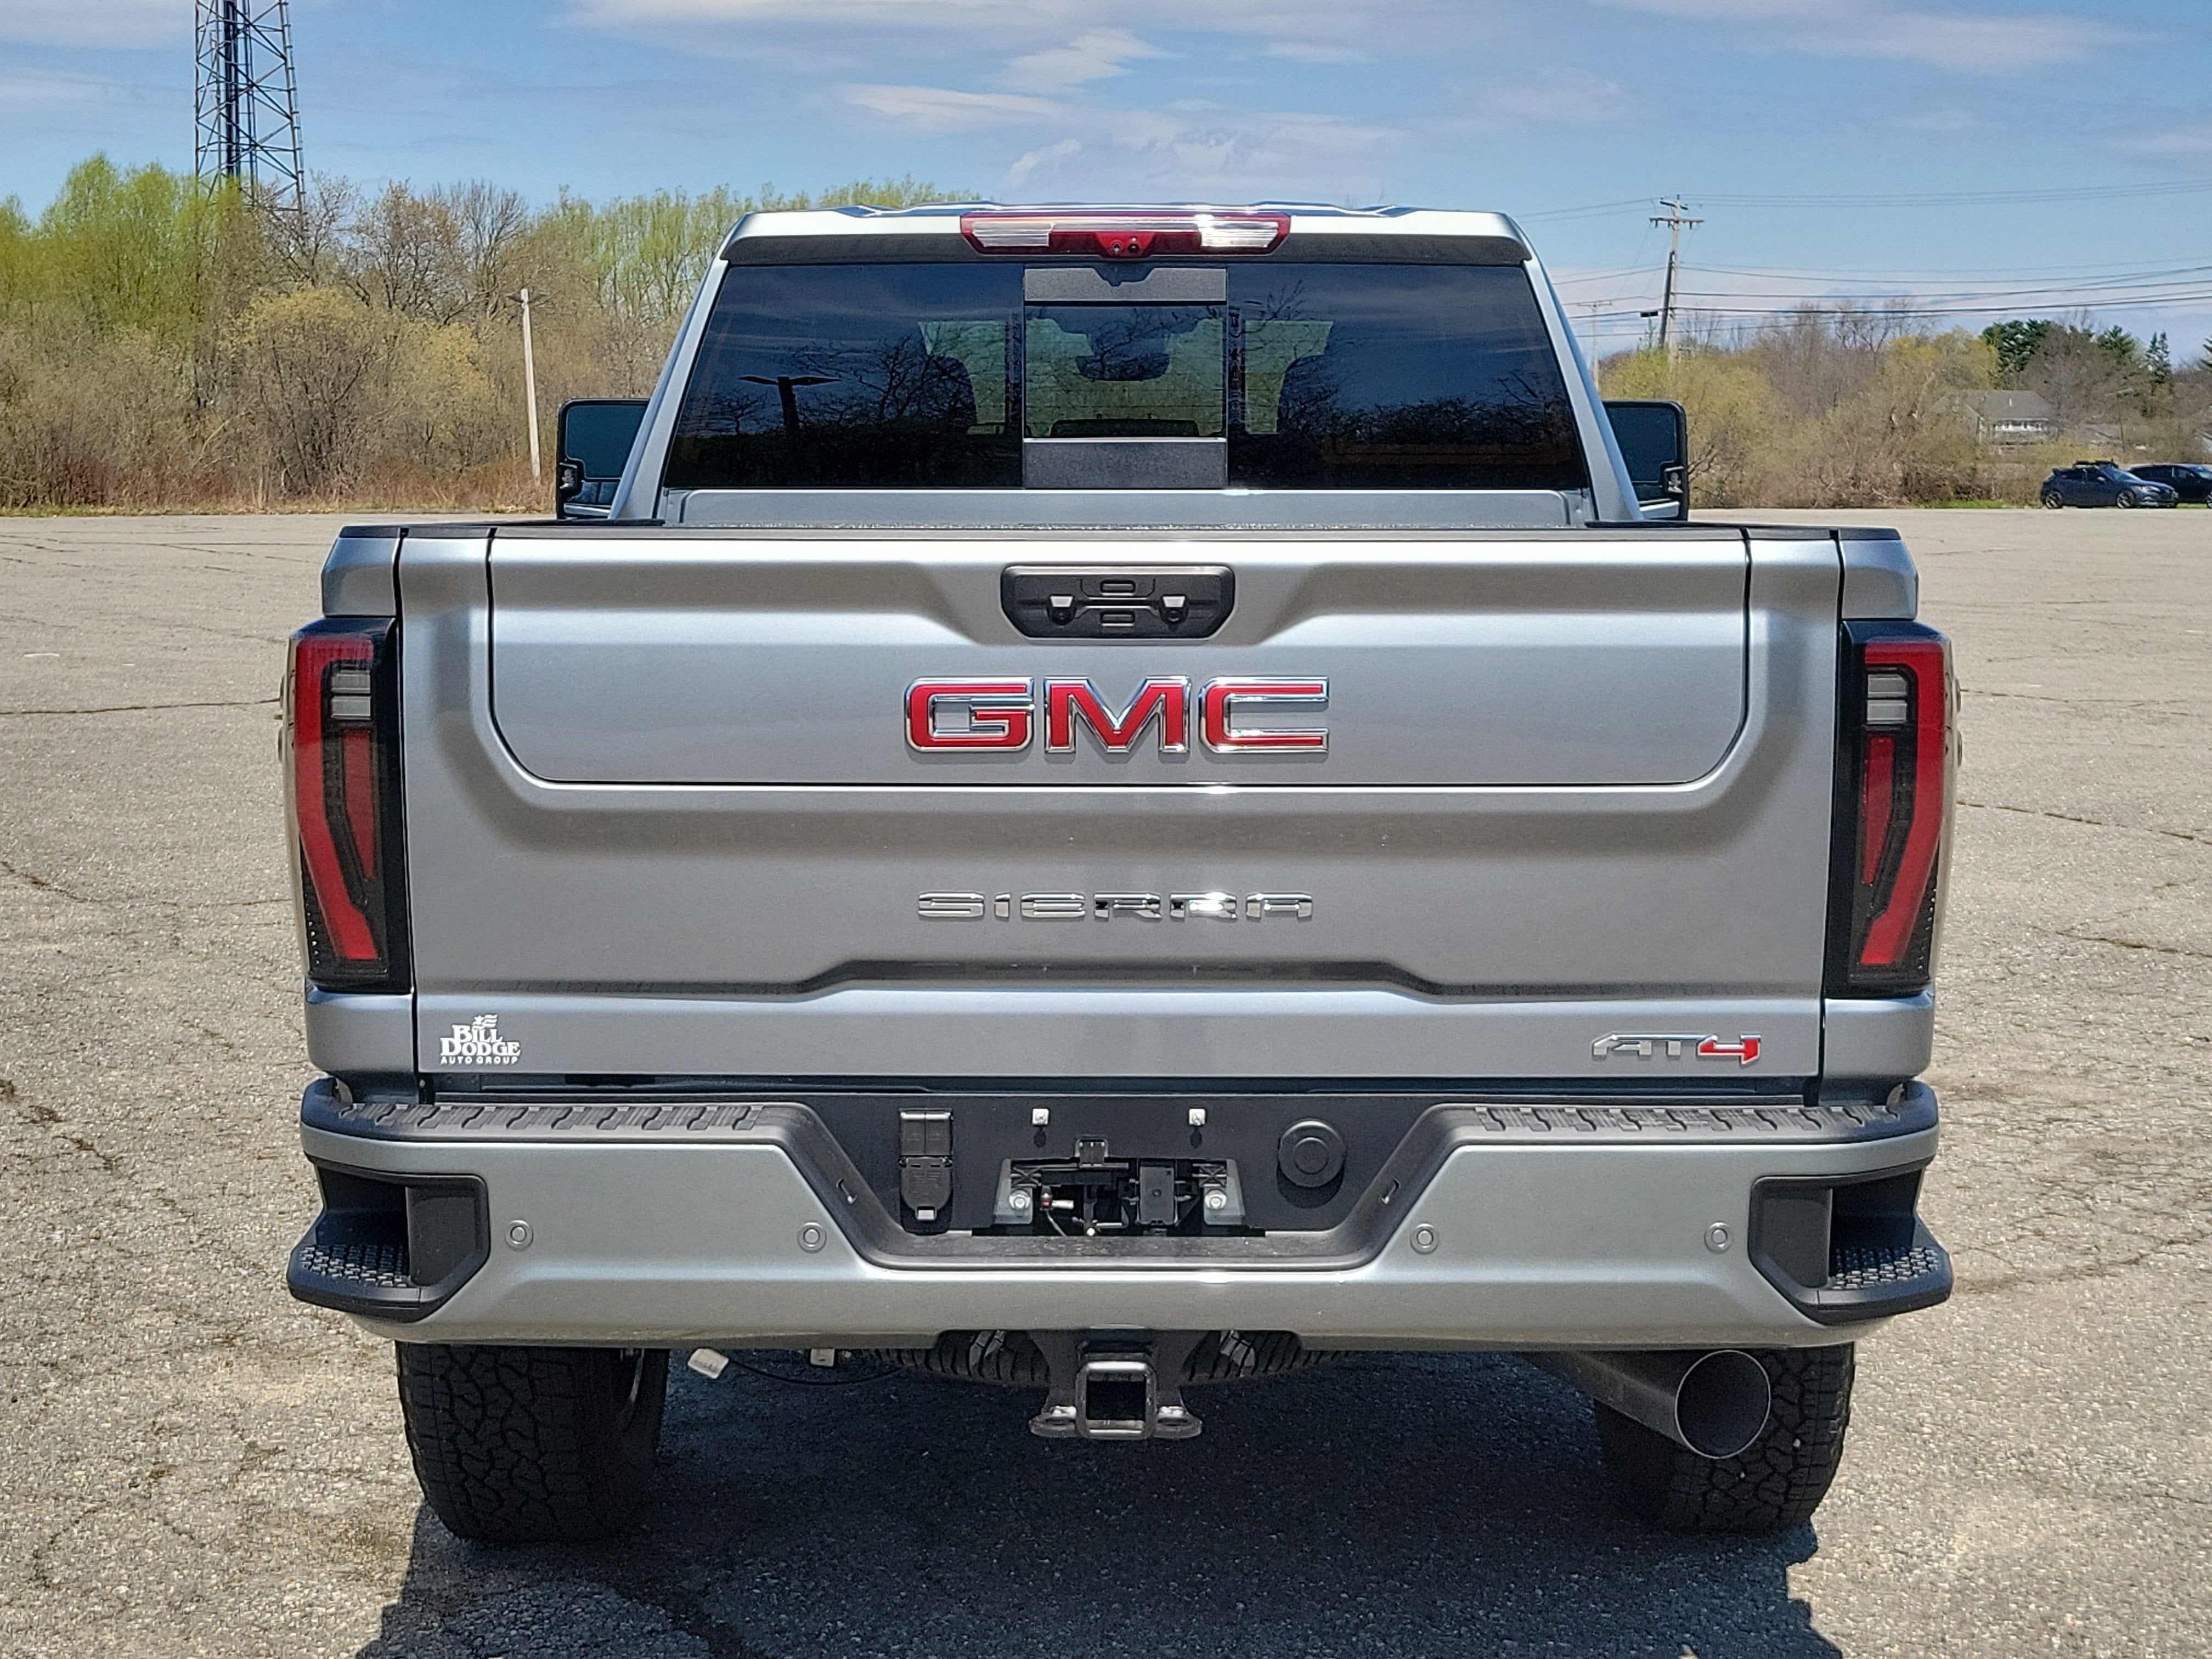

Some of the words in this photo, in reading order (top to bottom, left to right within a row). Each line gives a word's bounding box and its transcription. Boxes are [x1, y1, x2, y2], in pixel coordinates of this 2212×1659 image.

[905, 675, 1329, 753] GMC
[918, 891, 1313, 919] SIERRA
[440, 1037, 521, 1056] DODGE
[440, 1056, 473, 1065] AUTO
[476, 1056, 518, 1065] GROUP
[1593, 1033, 1761, 1065] AT4
